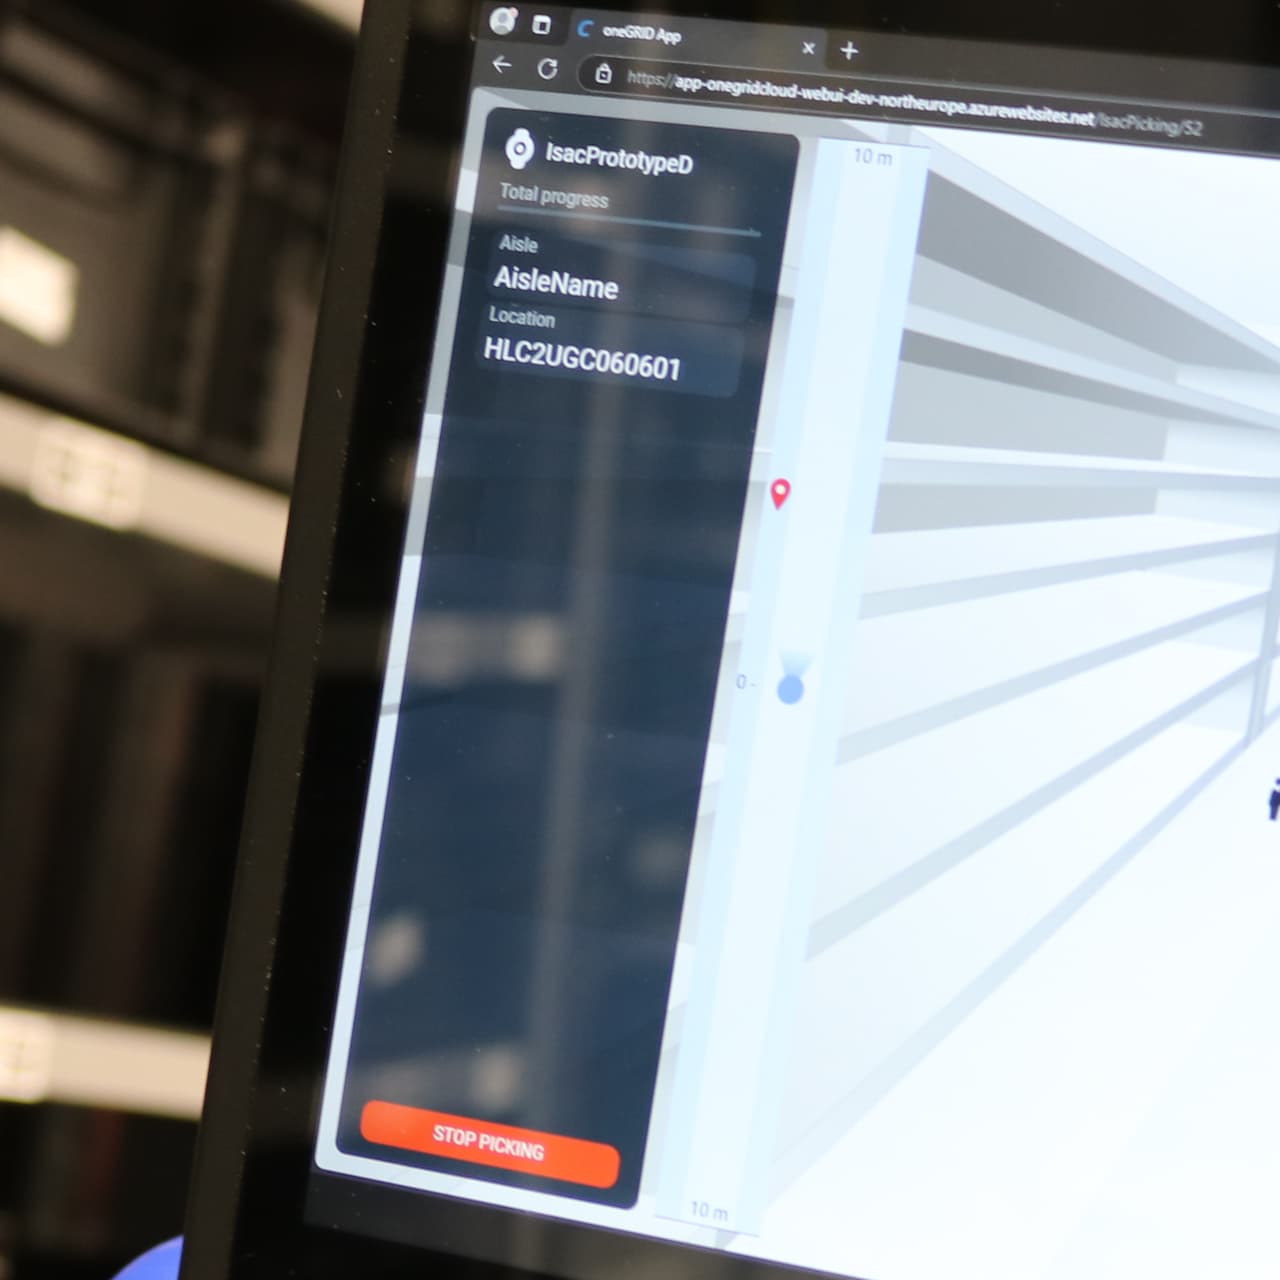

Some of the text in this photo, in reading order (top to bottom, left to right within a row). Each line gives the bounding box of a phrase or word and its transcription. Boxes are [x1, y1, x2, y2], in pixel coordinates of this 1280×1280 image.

[602, 25, 682, 45] oneGRID App
[546, 142, 694, 176] IsacPrototypeD
[855, 147, 893, 166] 10 m
[500, 182, 609, 209] Total progress
[499, 234, 539, 254] Aisle
[493, 265, 620, 300] AisleName
[489, 305, 556, 329] Location
[484, 336, 681, 381] HLC2UGC060601
[433, 1124, 545, 1161] STOP PICKING
[691, 1201, 729, 1222] 10 m
